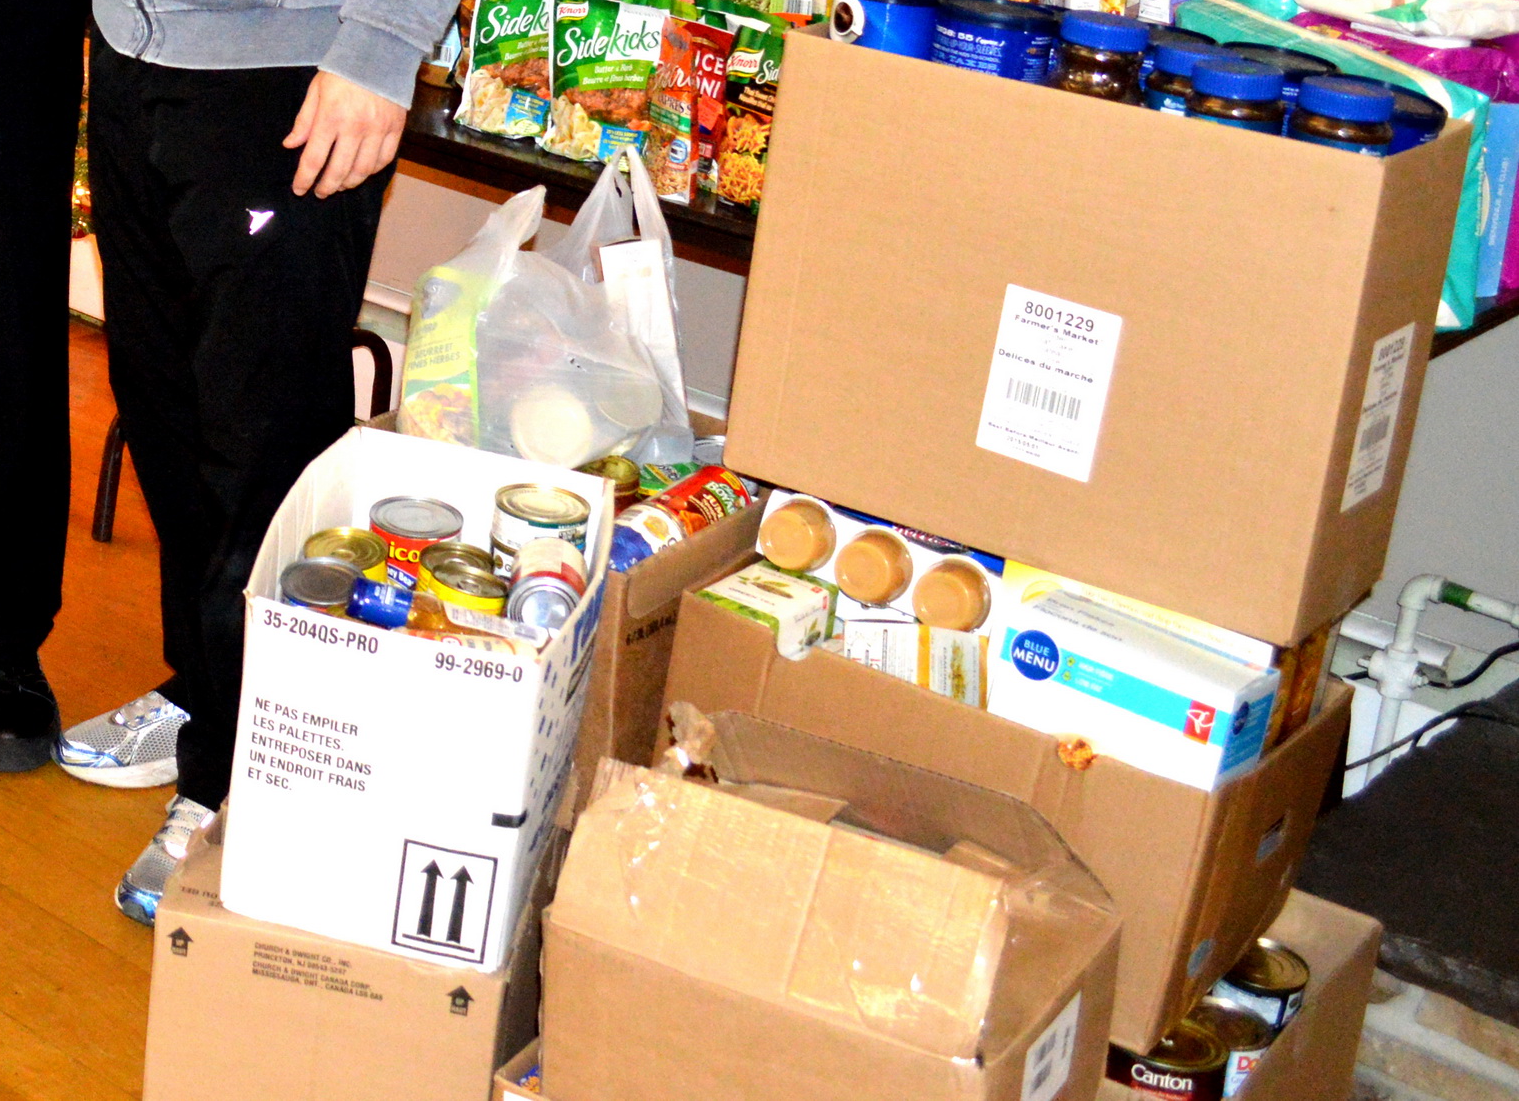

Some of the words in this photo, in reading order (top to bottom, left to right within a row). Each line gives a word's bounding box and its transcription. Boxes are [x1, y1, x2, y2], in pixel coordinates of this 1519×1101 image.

[557, 5, 587, 18] Knorr
[556, 21, 660, 66] Sidekicks
[594, 65, 615, 73] Butter
[728, 55, 758, 69] Knorr
[582, 77, 603, 85] Beurre
[609, 75, 624, 84] fines
[623, 75, 644, 83] herbes
[1014, 313, 1059, 334] Farmer's
[1062, 327, 1099, 346] Market
[1024, 300, 1095, 333] 8001229
[414, 342, 445, 360] BEURRE
[429, 350, 461, 365] HERBES
[998, 348, 1036, 366] Delices
[1039, 361, 1052, 371] du
[1054, 367, 1094, 384] marche
[263, 608, 379, 655] 35-204QS-PRO
[435, 651, 524, 684] 99-2969-0
[1023, 639, 1050, 656] BLUE
[1013, 647, 1055, 673] MENU
[254, 696, 270, 712] NE
[274, 701, 300, 721] PAS
[301, 707, 359, 737] EMPILER
[252, 713, 274, 731] LES
[277, 720, 345, 751] PALETTES.
[251, 732, 334, 768] ENTREPOSER
[336, 754, 373, 777] DANS
[247, 767, 263, 782] ET
[265, 770, 292, 792] SEC.
[249, 749, 267, 765] UN
[269, 754, 325, 784] ENDROIT
[327, 770, 367, 793] FRAIS
[254, 941, 283, 955] CHURCH
[291, 949, 320, 962] DWIGHT
[252, 960, 282, 973] CHURCH
[320, 974, 349, 987] CANADA
[324, 982, 354, 995] CANADA
[1131, 1063, 1194, 1092] Canton
